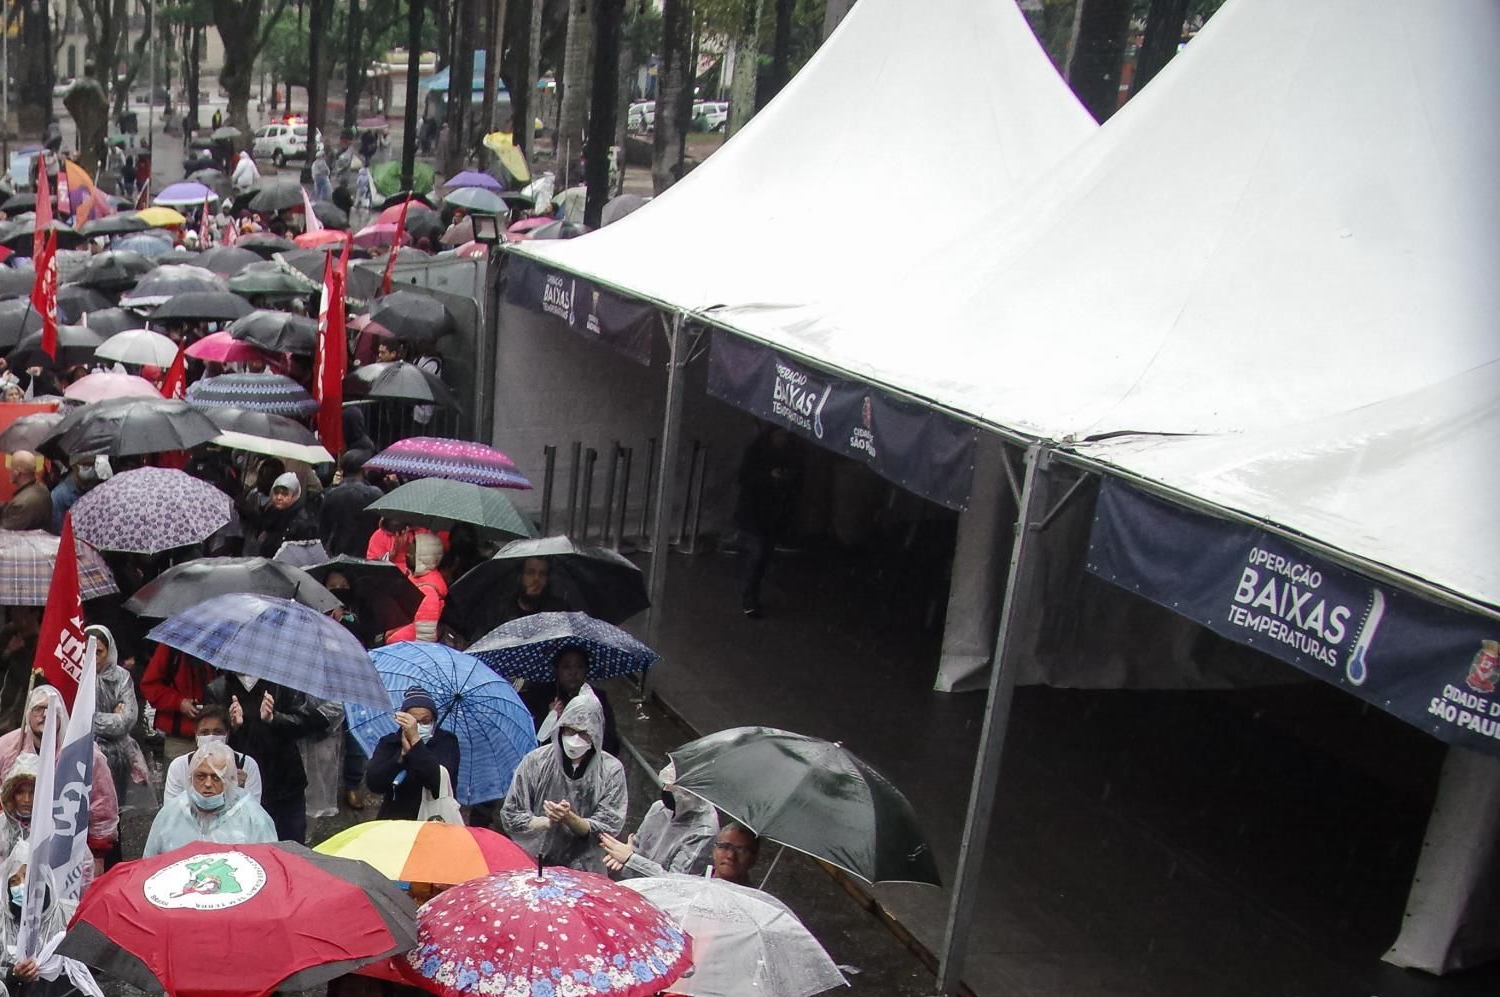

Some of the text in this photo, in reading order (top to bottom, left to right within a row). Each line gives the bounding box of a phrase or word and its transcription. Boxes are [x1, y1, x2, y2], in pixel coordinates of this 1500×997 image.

[1248, 546, 1323, 589] OPERAÇÃO
[1233, 566, 1351, 645] BAIXAS
[1227, 604, 1338, 668] TEMPERATURAS
[1428, 697, 1500, 740] SÃO PAUL
[1443, 684, 1500, 717] CIDADE D
